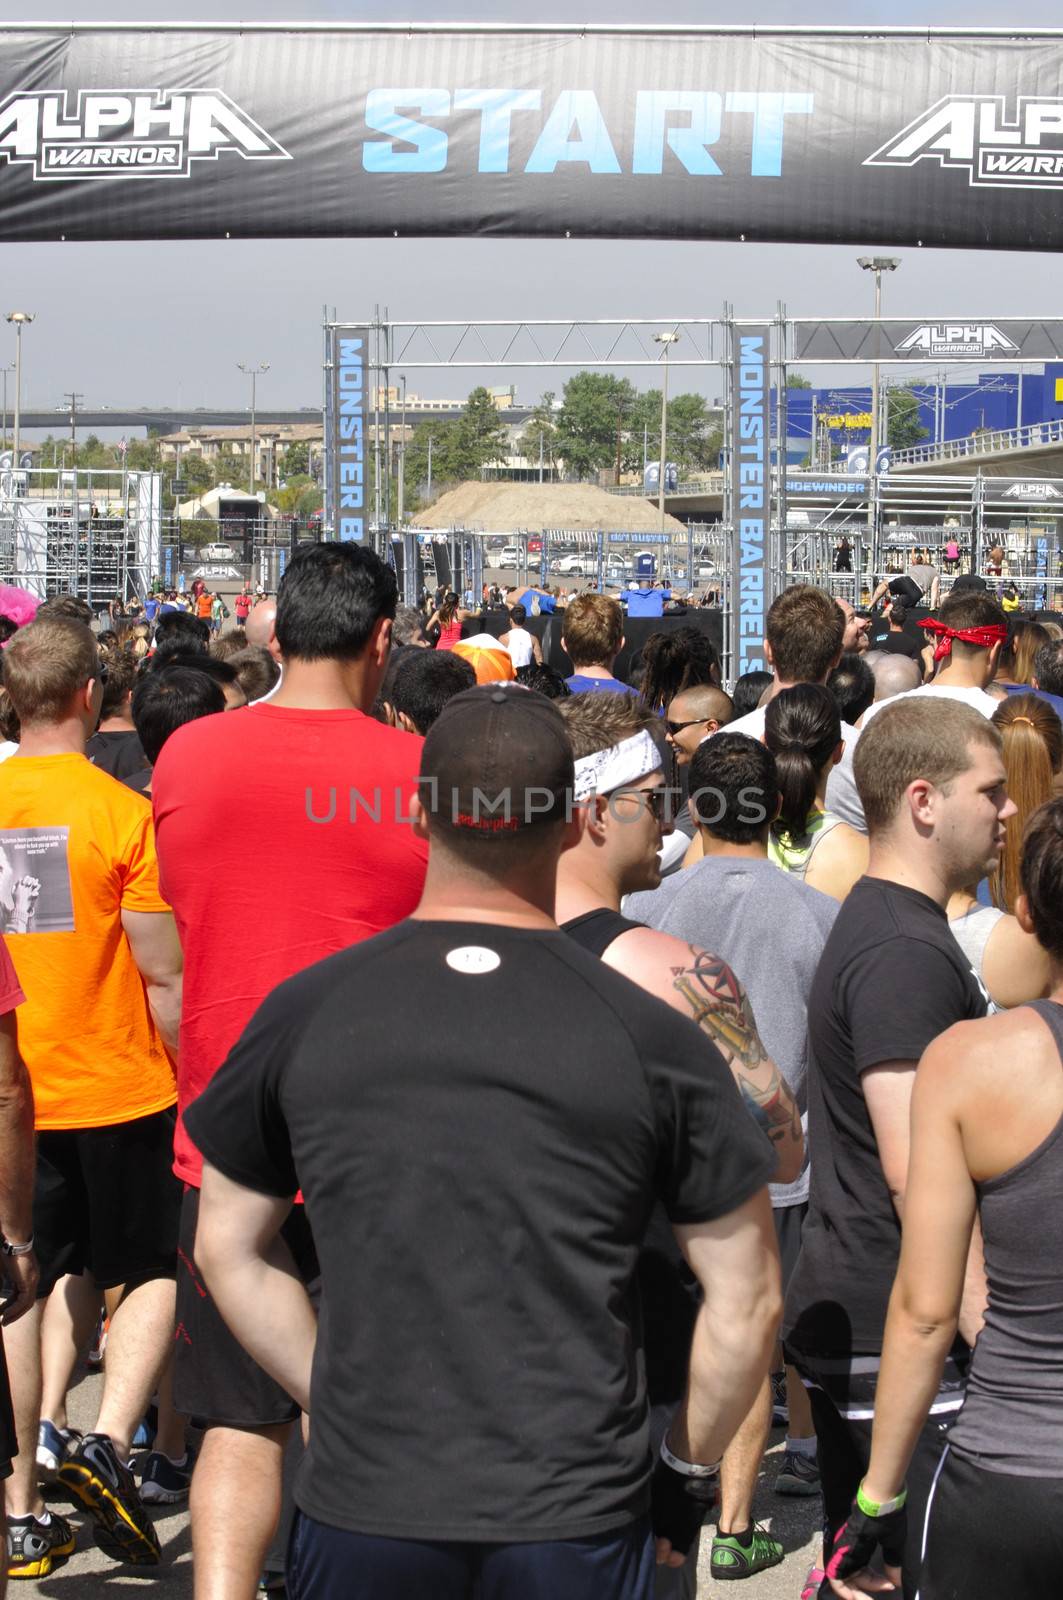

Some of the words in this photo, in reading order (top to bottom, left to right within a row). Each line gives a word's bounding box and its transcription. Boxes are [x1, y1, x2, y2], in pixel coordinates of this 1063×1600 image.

[0, 96, 272, 155] ALPHA
[361, 88, 814, 177] START
[48, 145, 180, 167] WARRIOR
[901, 326, 1014, 349] ALPHA
[933, 344, 981, 353] WARRIOR
[339, 337, 364, 509] MONSTER
[739, 337, 765, 509] MONSTER
[1004, 484, 1061, 497] ALPHA
[192, 565, 241, 577] ALPHA
[739, 518, 765, 676] BARRELS
